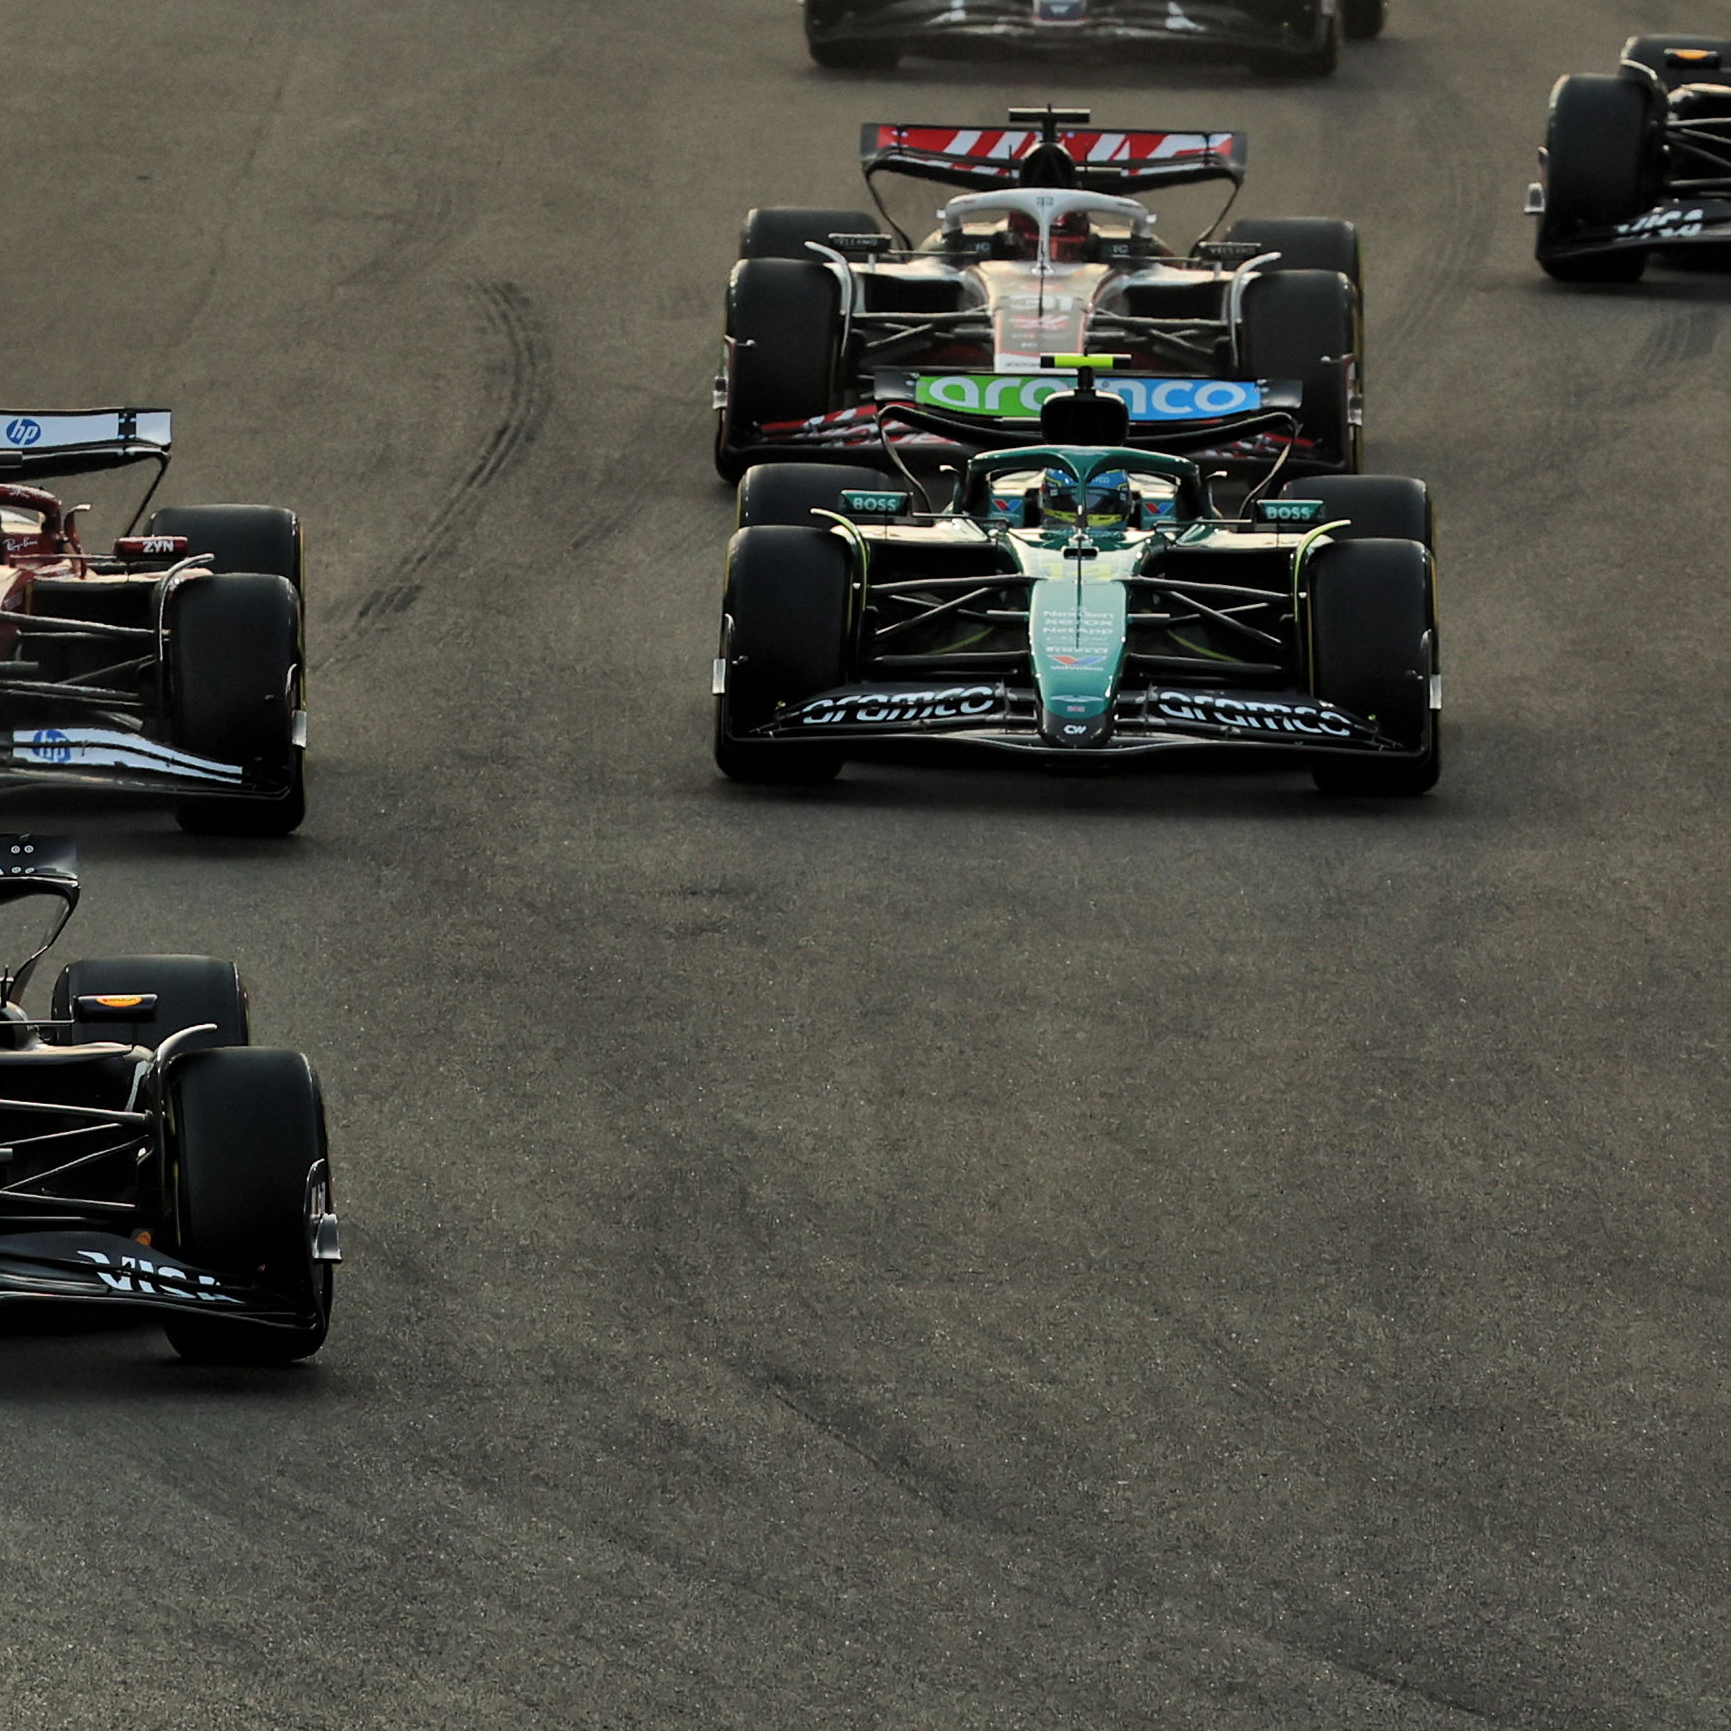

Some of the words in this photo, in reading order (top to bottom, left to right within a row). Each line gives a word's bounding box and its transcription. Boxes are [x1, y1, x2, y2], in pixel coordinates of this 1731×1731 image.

[10, 419, 39, 445] hp
[853, 497, 897, 511] BOSS
[1266, 506, 1311, 520] BOSS
[143, 540, 175, 553] ZYN
[801, 686, 994, 724] aramco
[1159, 691, 1351, 737] aramco
[77, 1248, 246, 1305] VISA
